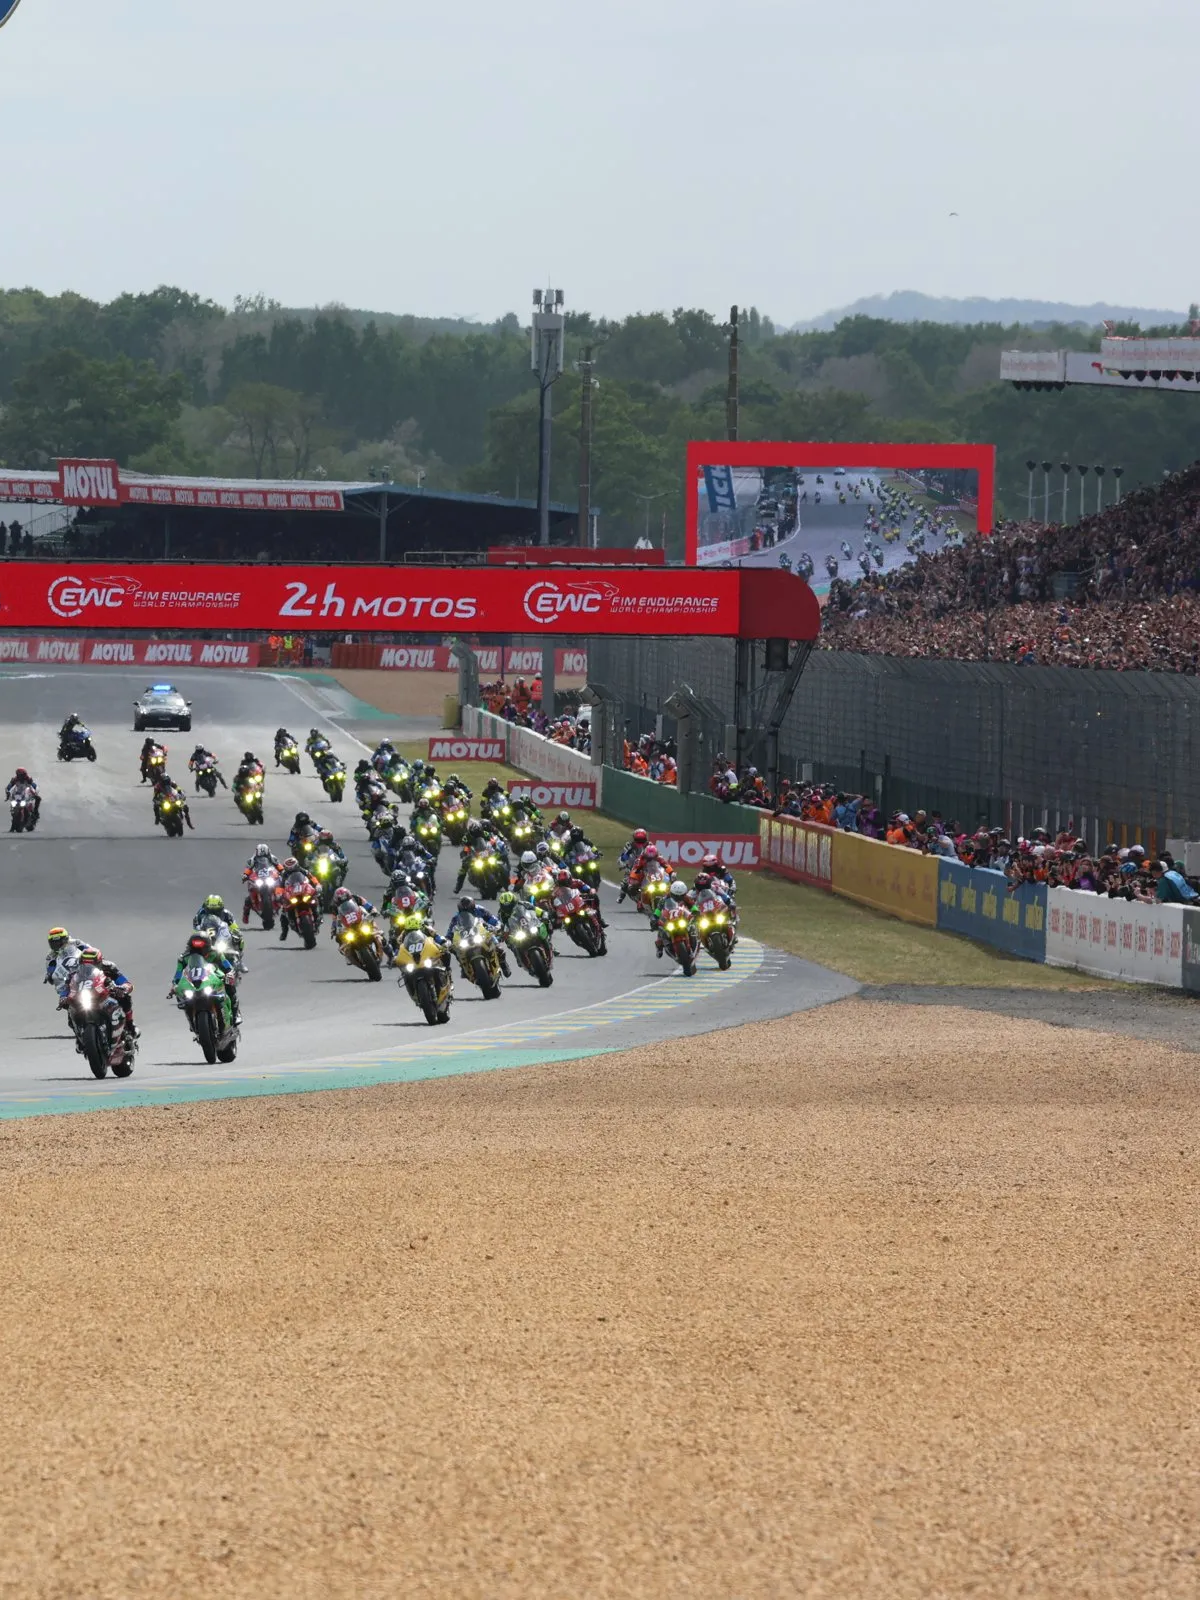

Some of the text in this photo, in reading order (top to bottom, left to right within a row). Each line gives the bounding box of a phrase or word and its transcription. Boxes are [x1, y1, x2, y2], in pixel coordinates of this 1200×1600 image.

[64, 465, 116, 499] MOTUL
[60, 588, 125, 608] EWC
[134, 591, 241, 602] FIM ENDURANCE
[279, 582, 477, 618] 24h MOTOS
[536, 593, 602, 612] EWC
[611, 596, 719, 607] FIM ENDURANCE
[37, 641, 80, 660] MOTUL
[90, 643, 135, 661] MOTUL
[144, 644, 193, 662] MOTUL
[200, 644, 250, 663] MOTUL
[380, 648, 435, 669] MOTUL
[431, 741, 503, 758] MOTUL
[511, 787, 594, 806] MOTUL
[655, 840, 760, 865] MOTUL
[78, 980, 93, 990] 12
